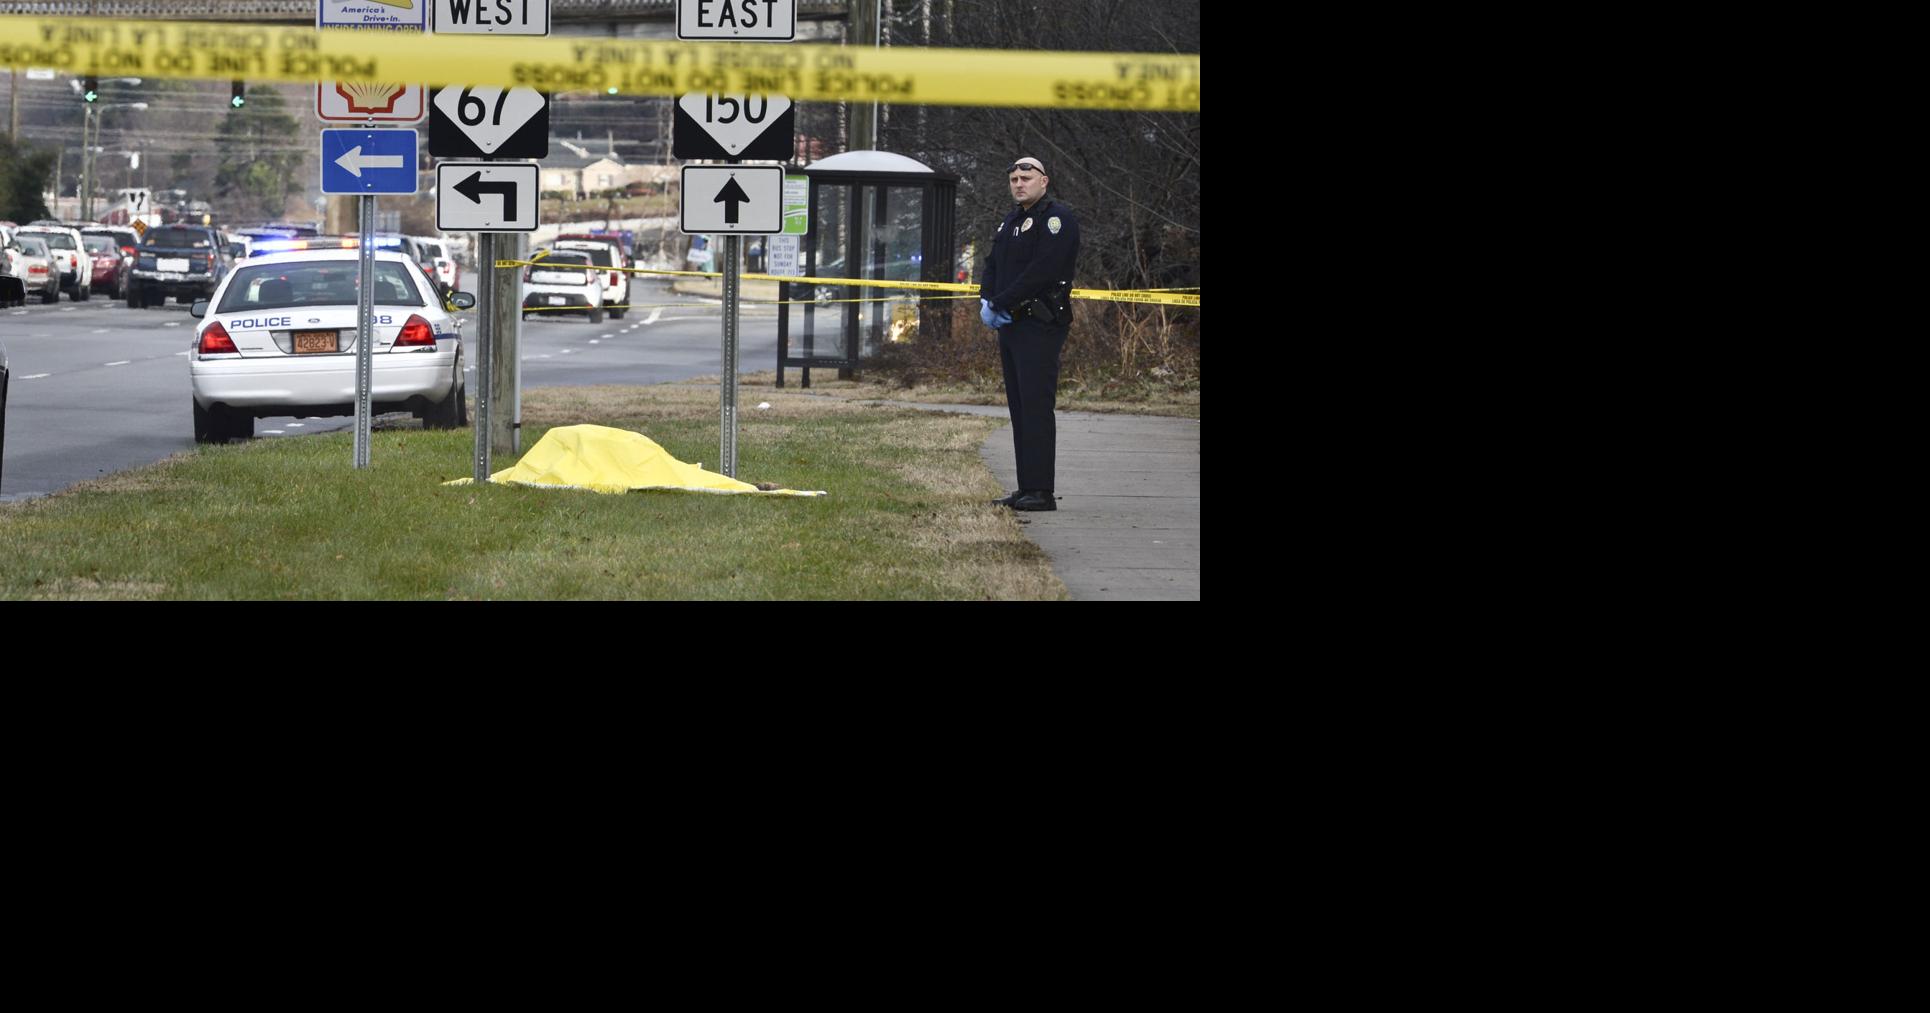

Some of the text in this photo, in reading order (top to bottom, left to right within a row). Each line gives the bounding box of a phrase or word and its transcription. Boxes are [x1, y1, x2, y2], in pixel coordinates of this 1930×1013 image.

[341, 6, 385, 14] America's
[449, 0, 528, 25] WEST
[697, 0, 778, 28] EAST
[281, 52, 377, 77] POLICE
[815, 72, 914, 95] POLICE
[457, 84, 512, 126] 67
[706, 92, 768, 124] 150
[230, 316, 291, 329] POLICE
